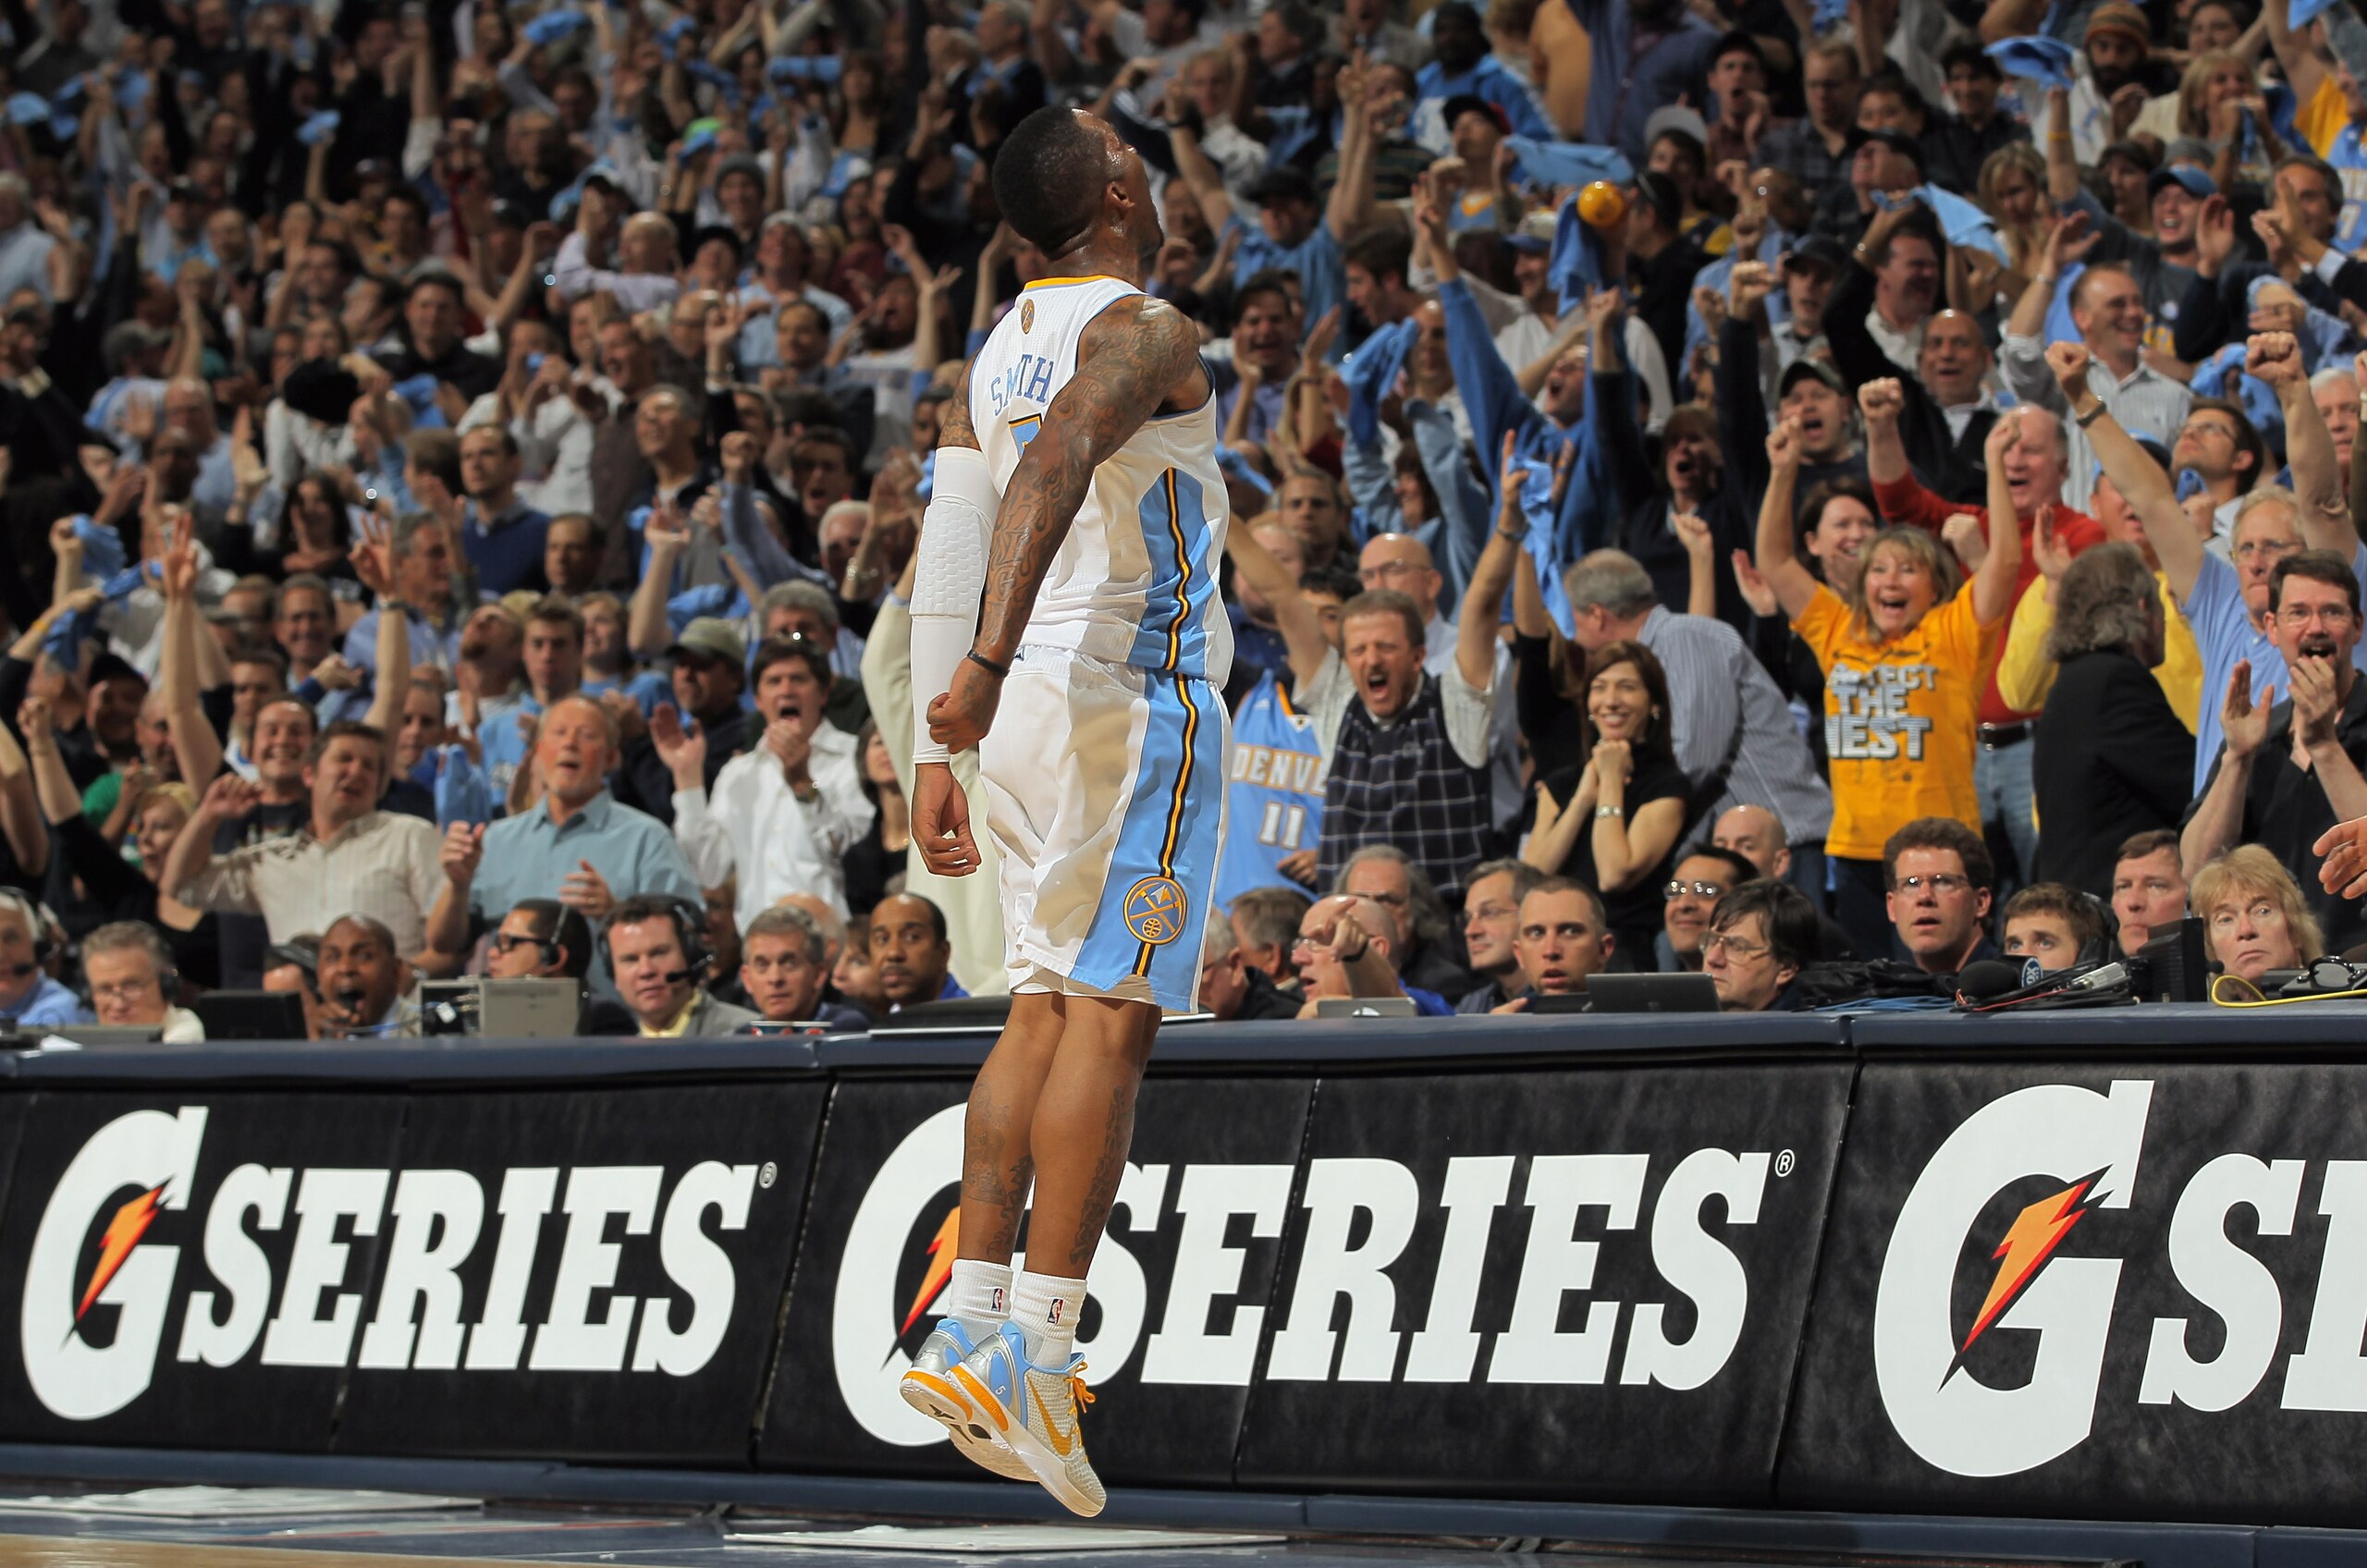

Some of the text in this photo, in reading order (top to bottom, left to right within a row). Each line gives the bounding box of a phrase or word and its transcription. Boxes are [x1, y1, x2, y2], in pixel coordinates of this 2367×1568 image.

[990, 354, 1054, 416] SMTH
[1832, 685, 1908, 718] THE
[1258, 801, 1306, 851] 11
[22, 1107, 758, 1419] G SERIES
[1073, 1148, 1771, 1390] SERIES
[1874, 1080, 2154, 1476] G
[995, 1385, 1006, 1395] 5
